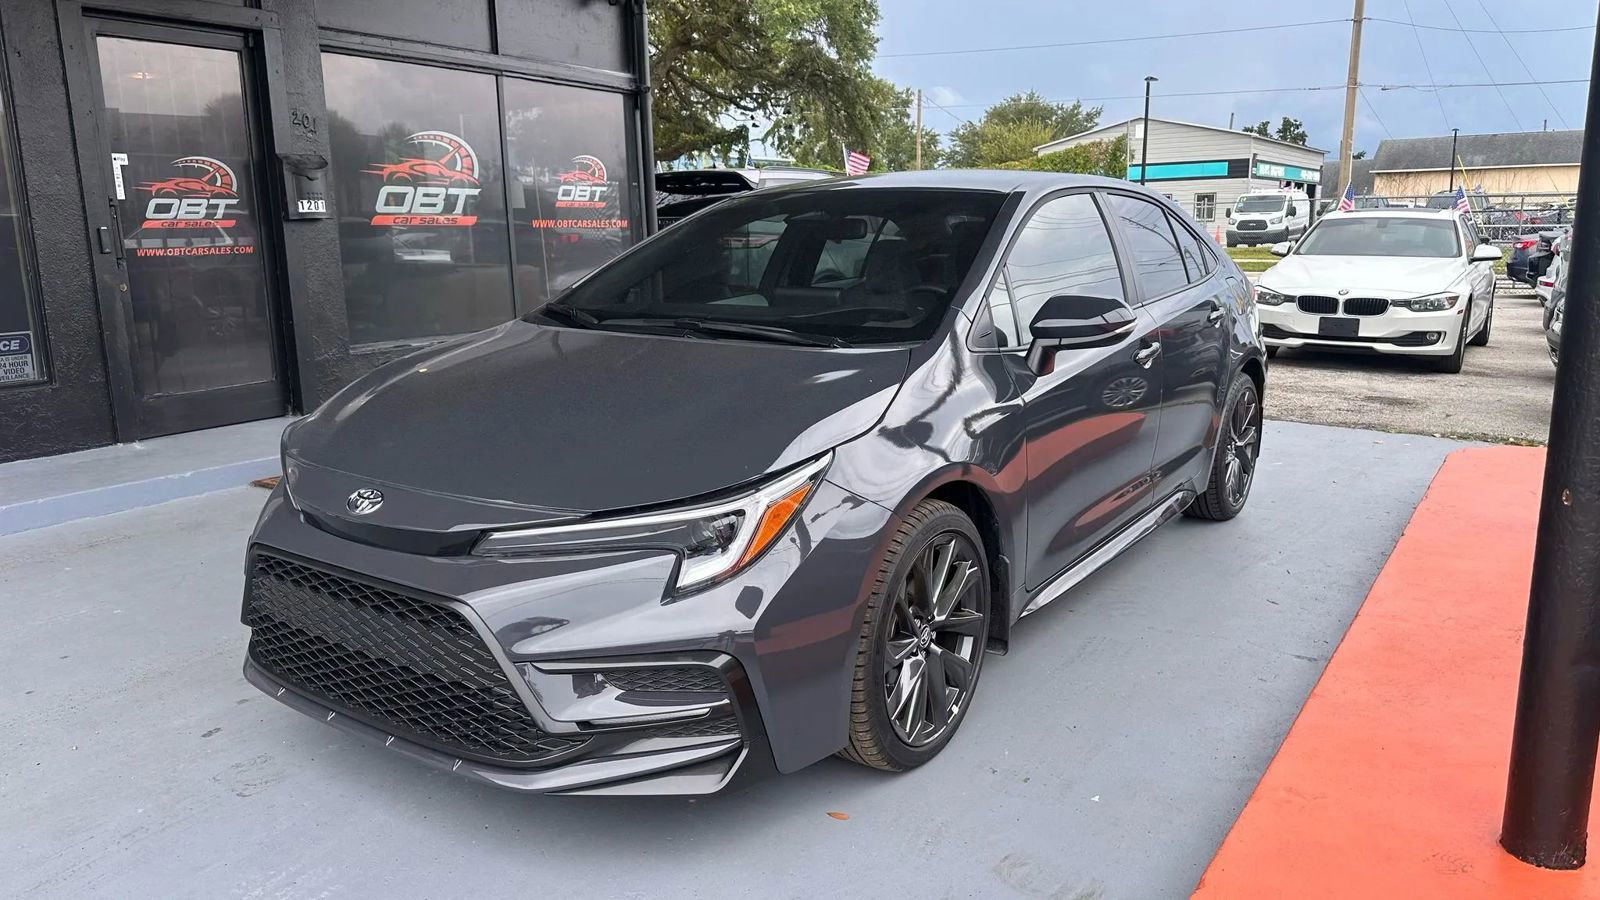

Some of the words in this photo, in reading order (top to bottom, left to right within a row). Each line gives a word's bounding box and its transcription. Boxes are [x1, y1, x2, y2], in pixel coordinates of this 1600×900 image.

[557, 185, 608, 201] OBT
[375, 185, 482, 215] OBT
[145, 198, 240, 219] OBT
[298, 200, 325, 212] 1201
[161, 220, 181, 228] car
[184, 220, 219, 228] sales
[393, 216, 416, 225] car
[418, 216, 458, 225] sales
[532, 219, 628, 228] WWW.OBTCARSALES.COM
[136, 246, 254, 257] WWW.OBTCARSALES.COM
[8, 360, 29, 368] HOUR
[3, 367, 25, 375] VIDEO
